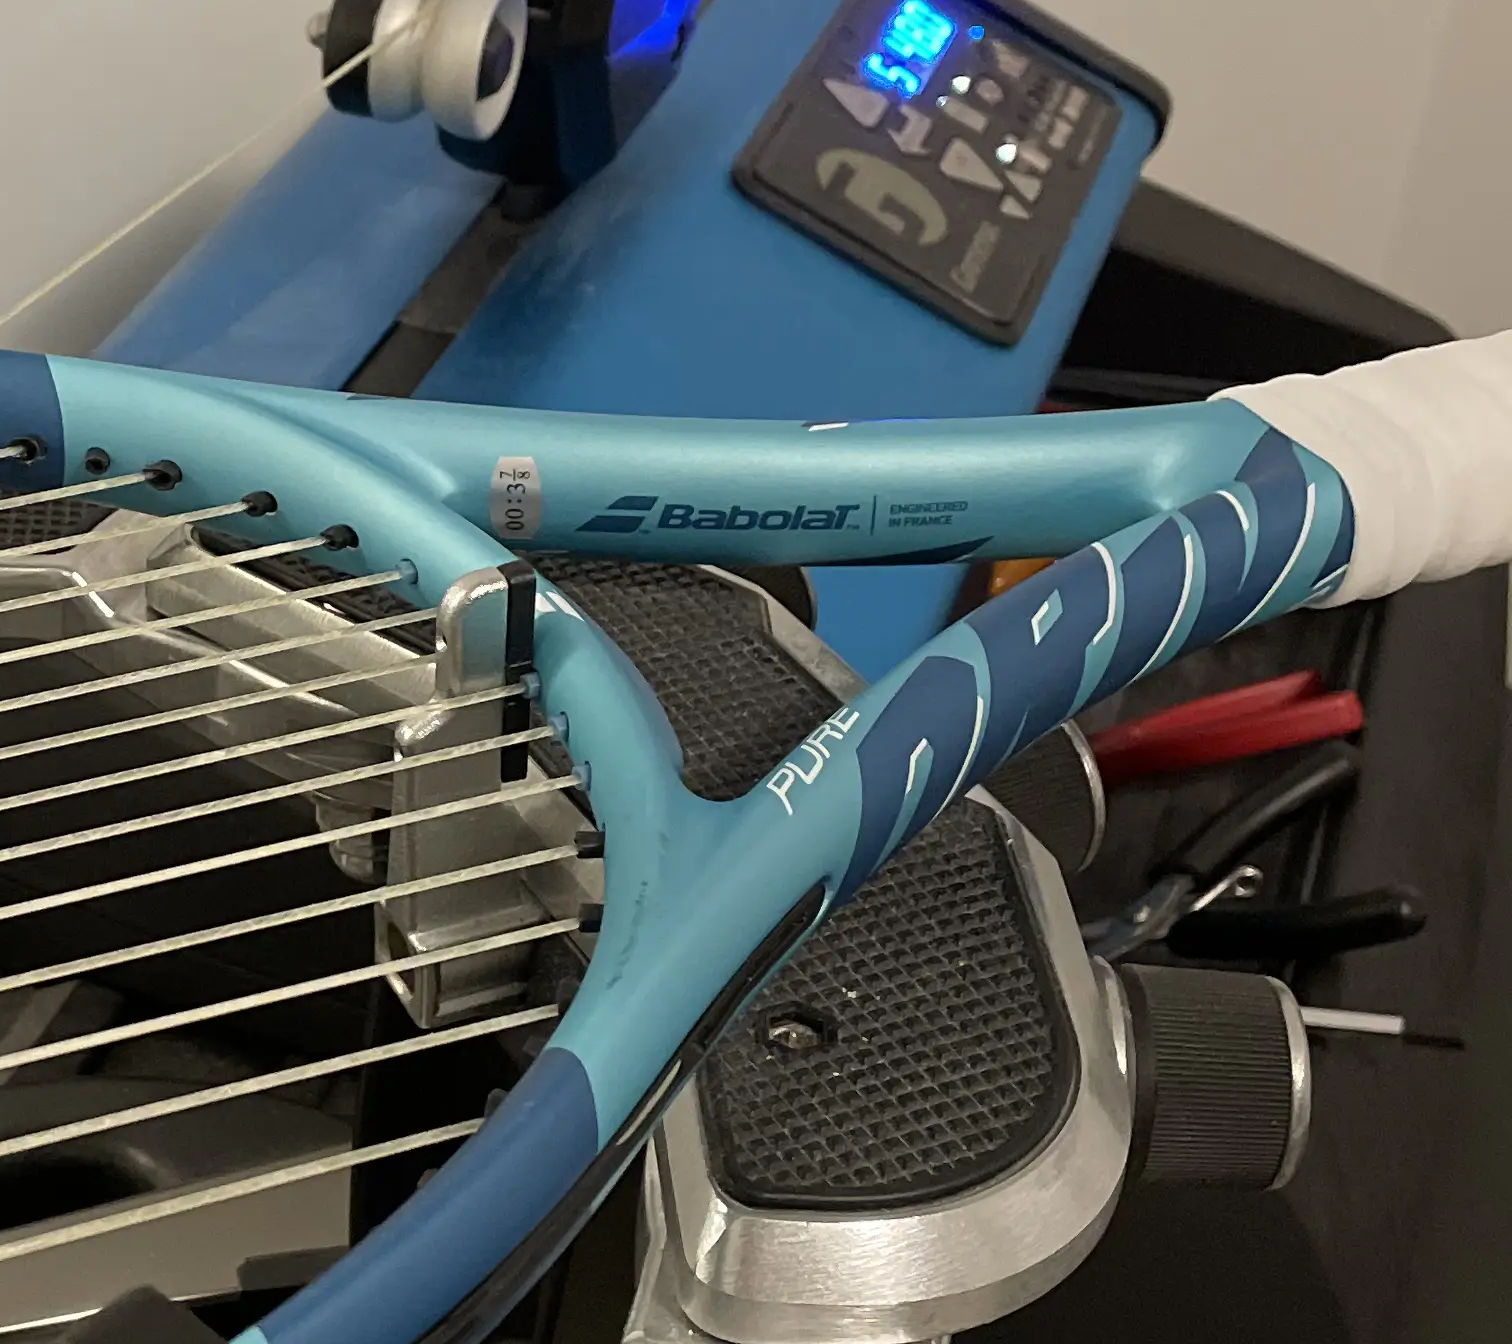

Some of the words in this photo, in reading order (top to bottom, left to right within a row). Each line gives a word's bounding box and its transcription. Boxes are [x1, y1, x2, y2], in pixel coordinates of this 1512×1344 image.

[889, 517, 901, 528] IN
[904, 515, 953, 527] FRANCE
[766, 707, 860, 816] PURE
